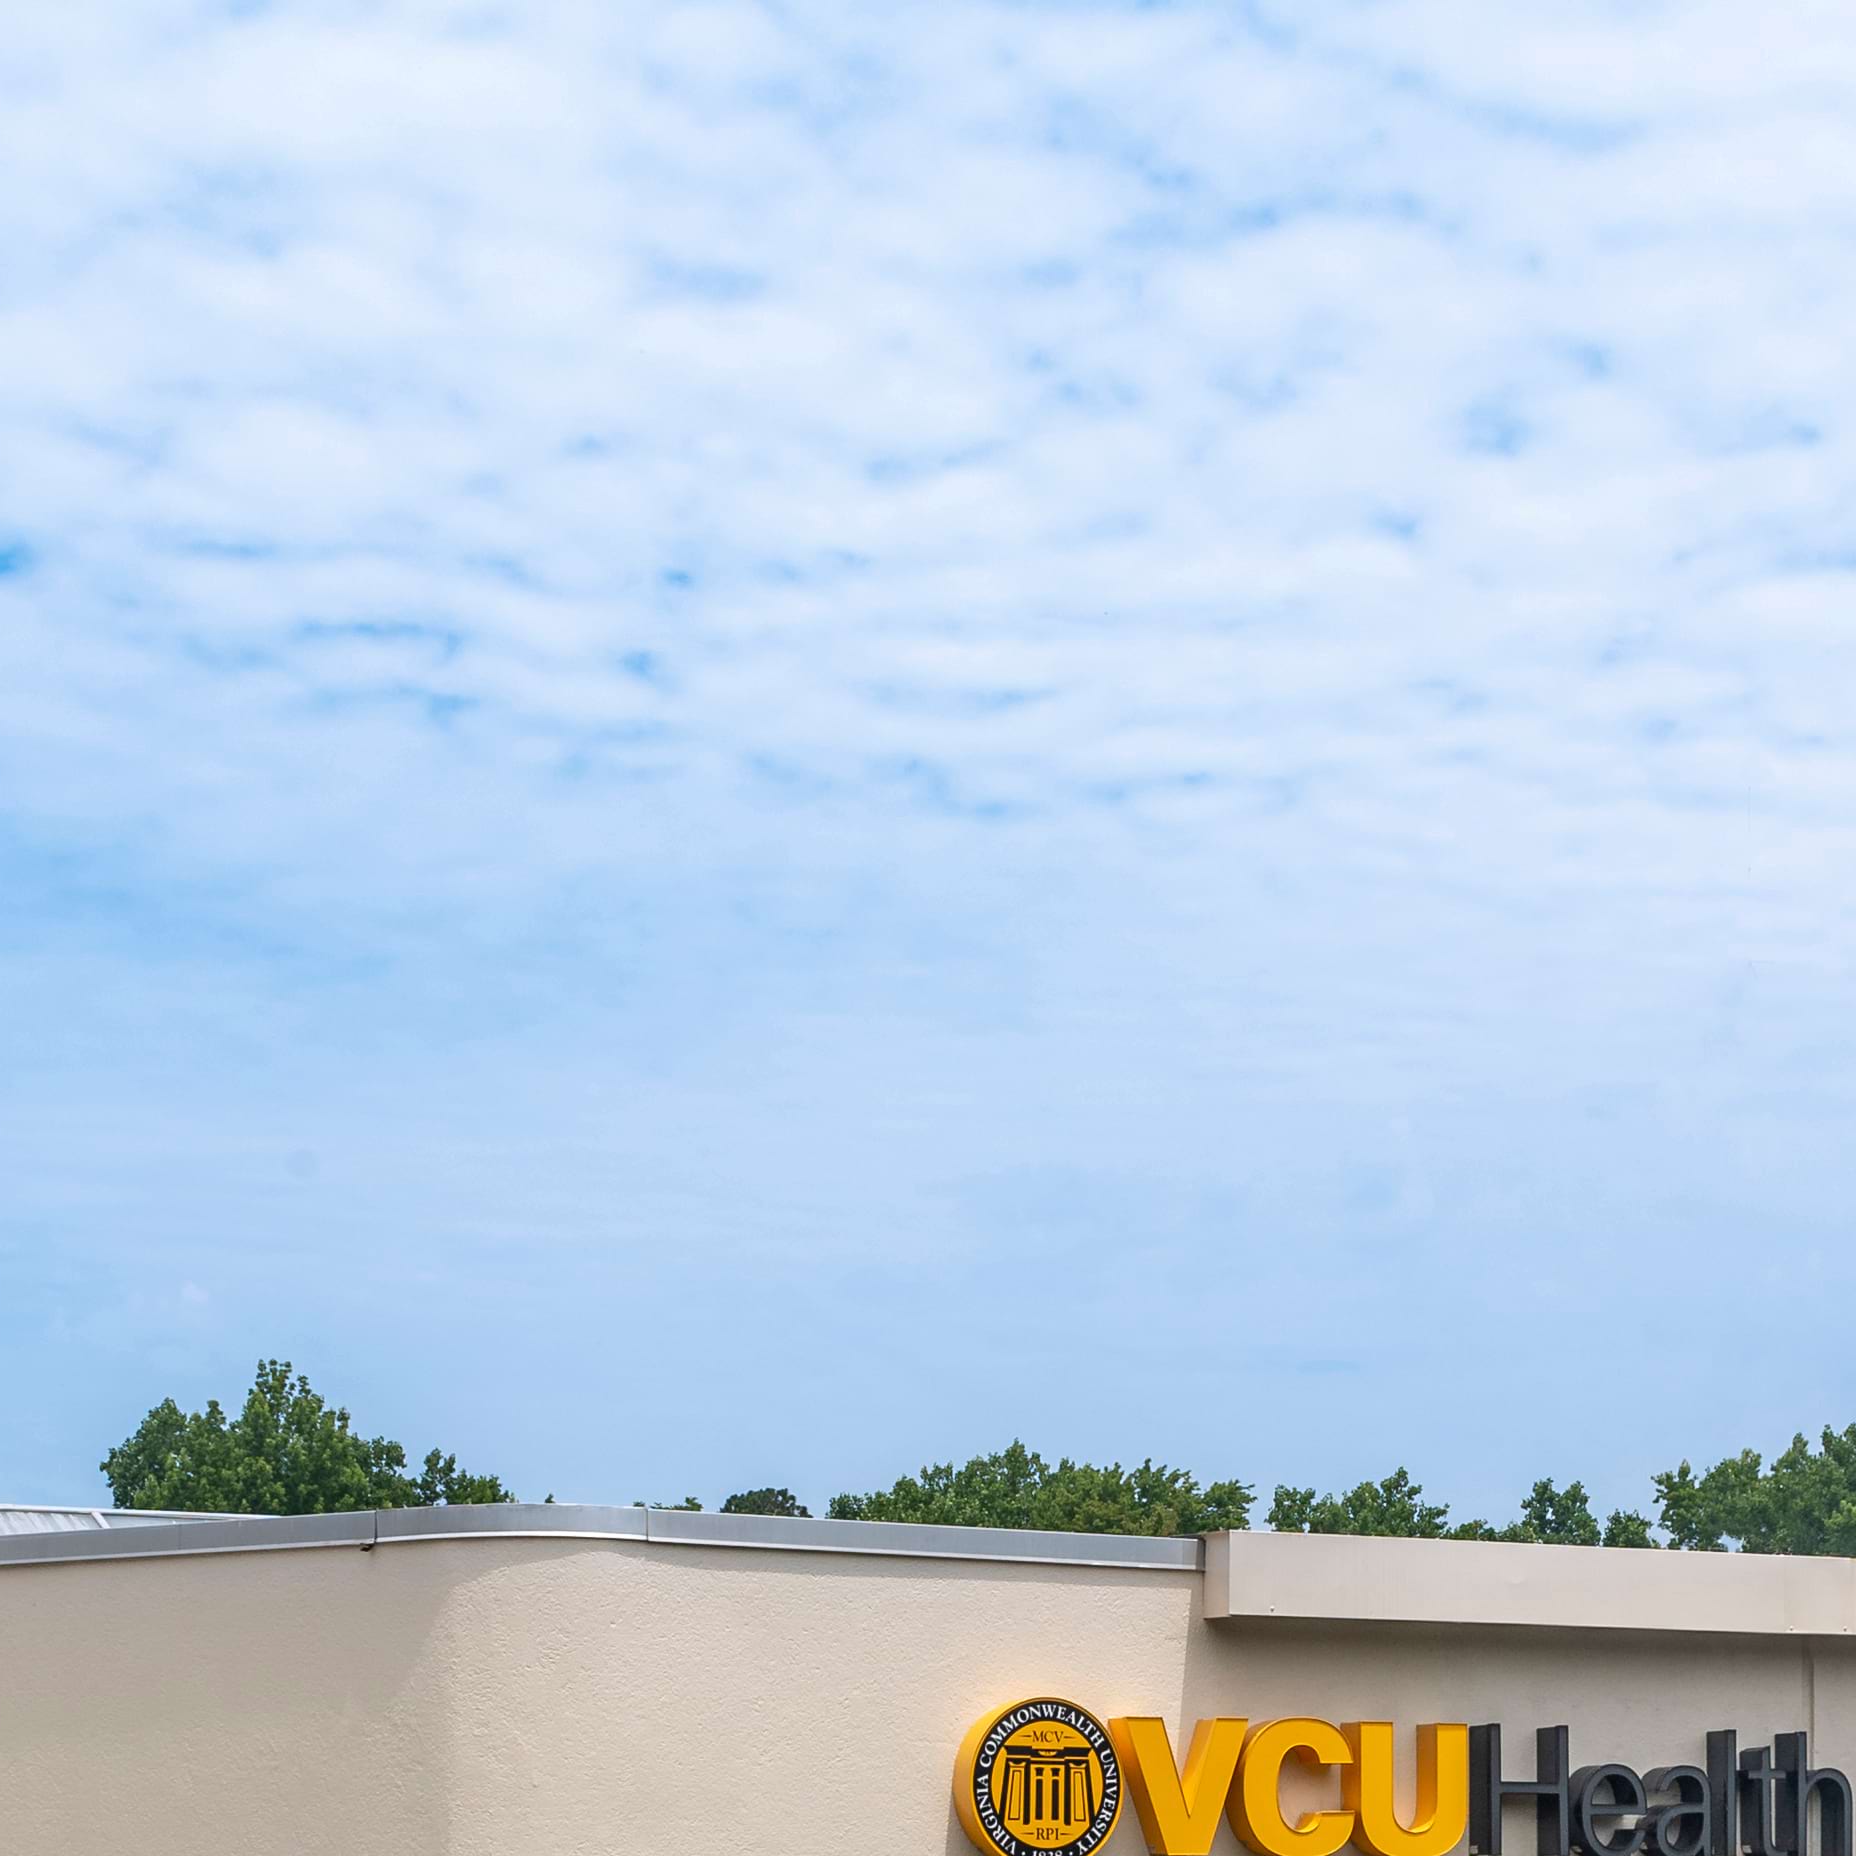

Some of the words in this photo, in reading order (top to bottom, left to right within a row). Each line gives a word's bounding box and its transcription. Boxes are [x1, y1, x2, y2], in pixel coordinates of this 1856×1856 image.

[979, 1704, 1105, 1768] COMMONWEALTH
[1032, 1730, 1064, 1743] MCV
[976, 1773, 1016, 1856] VIRGINIA
[1035, 1827, 1061, 1841] RPI
[1076, 1749, 1118, 1856] UNIVERSITY
